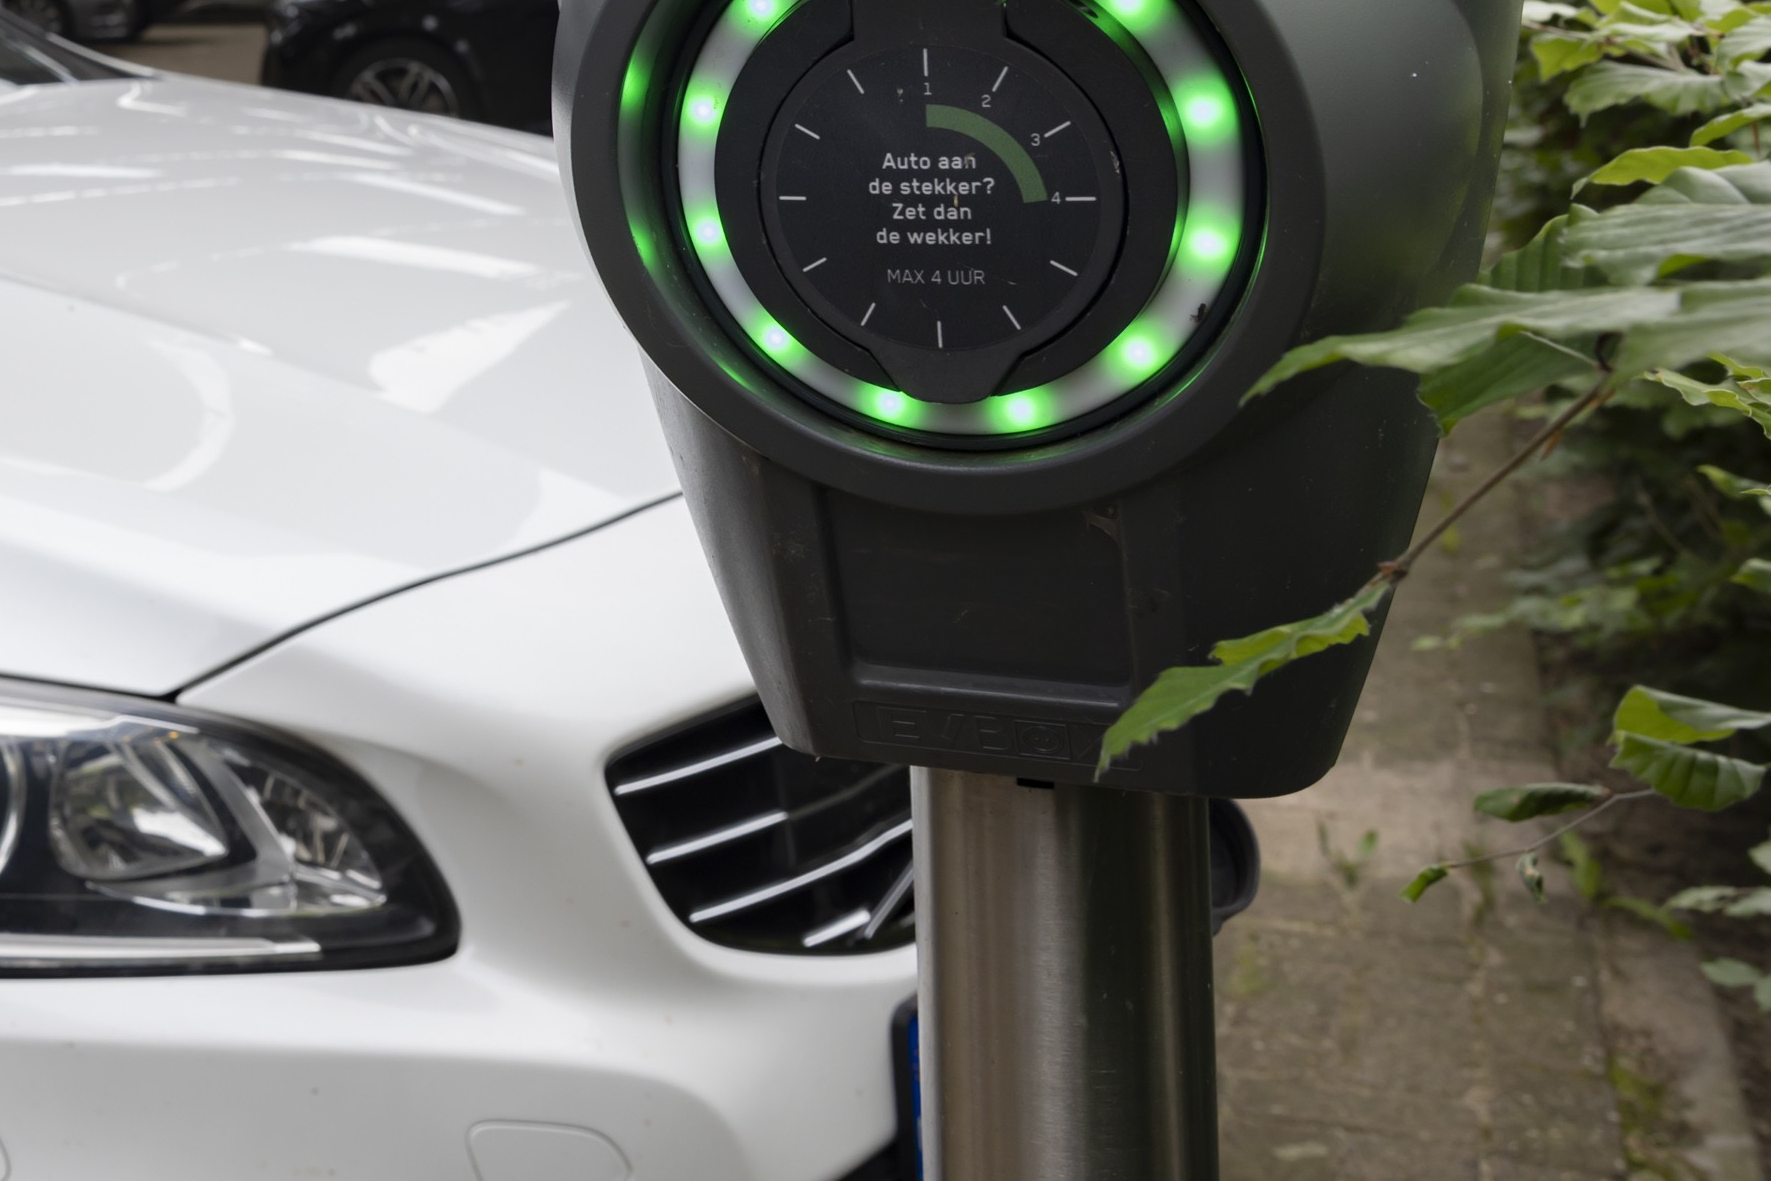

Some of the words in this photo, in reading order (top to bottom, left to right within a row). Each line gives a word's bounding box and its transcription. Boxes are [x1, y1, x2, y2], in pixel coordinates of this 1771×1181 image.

[924, 82, 932, 95] 1
[982, 94, 991, 108] 2
[1031, 133, 1040, 146] 3
[882, 153, 931, 169] Auto
[938, 156, 976, 169] aan
[869, 178, 892, 194] de
[900, 177, 995, 195] stekker?
[1051, 191, 1061, 204] 4
[892, 203, 926, 220] Zet
[933, 203, 971, 220] dan
[876, 228, 900, 244] de
[907, 228, 991, 245] wekker!
[887, 269, 925, 284] MAX
[931, 270, 942, 284] 4
[948, 269, 985, 285] UUR
